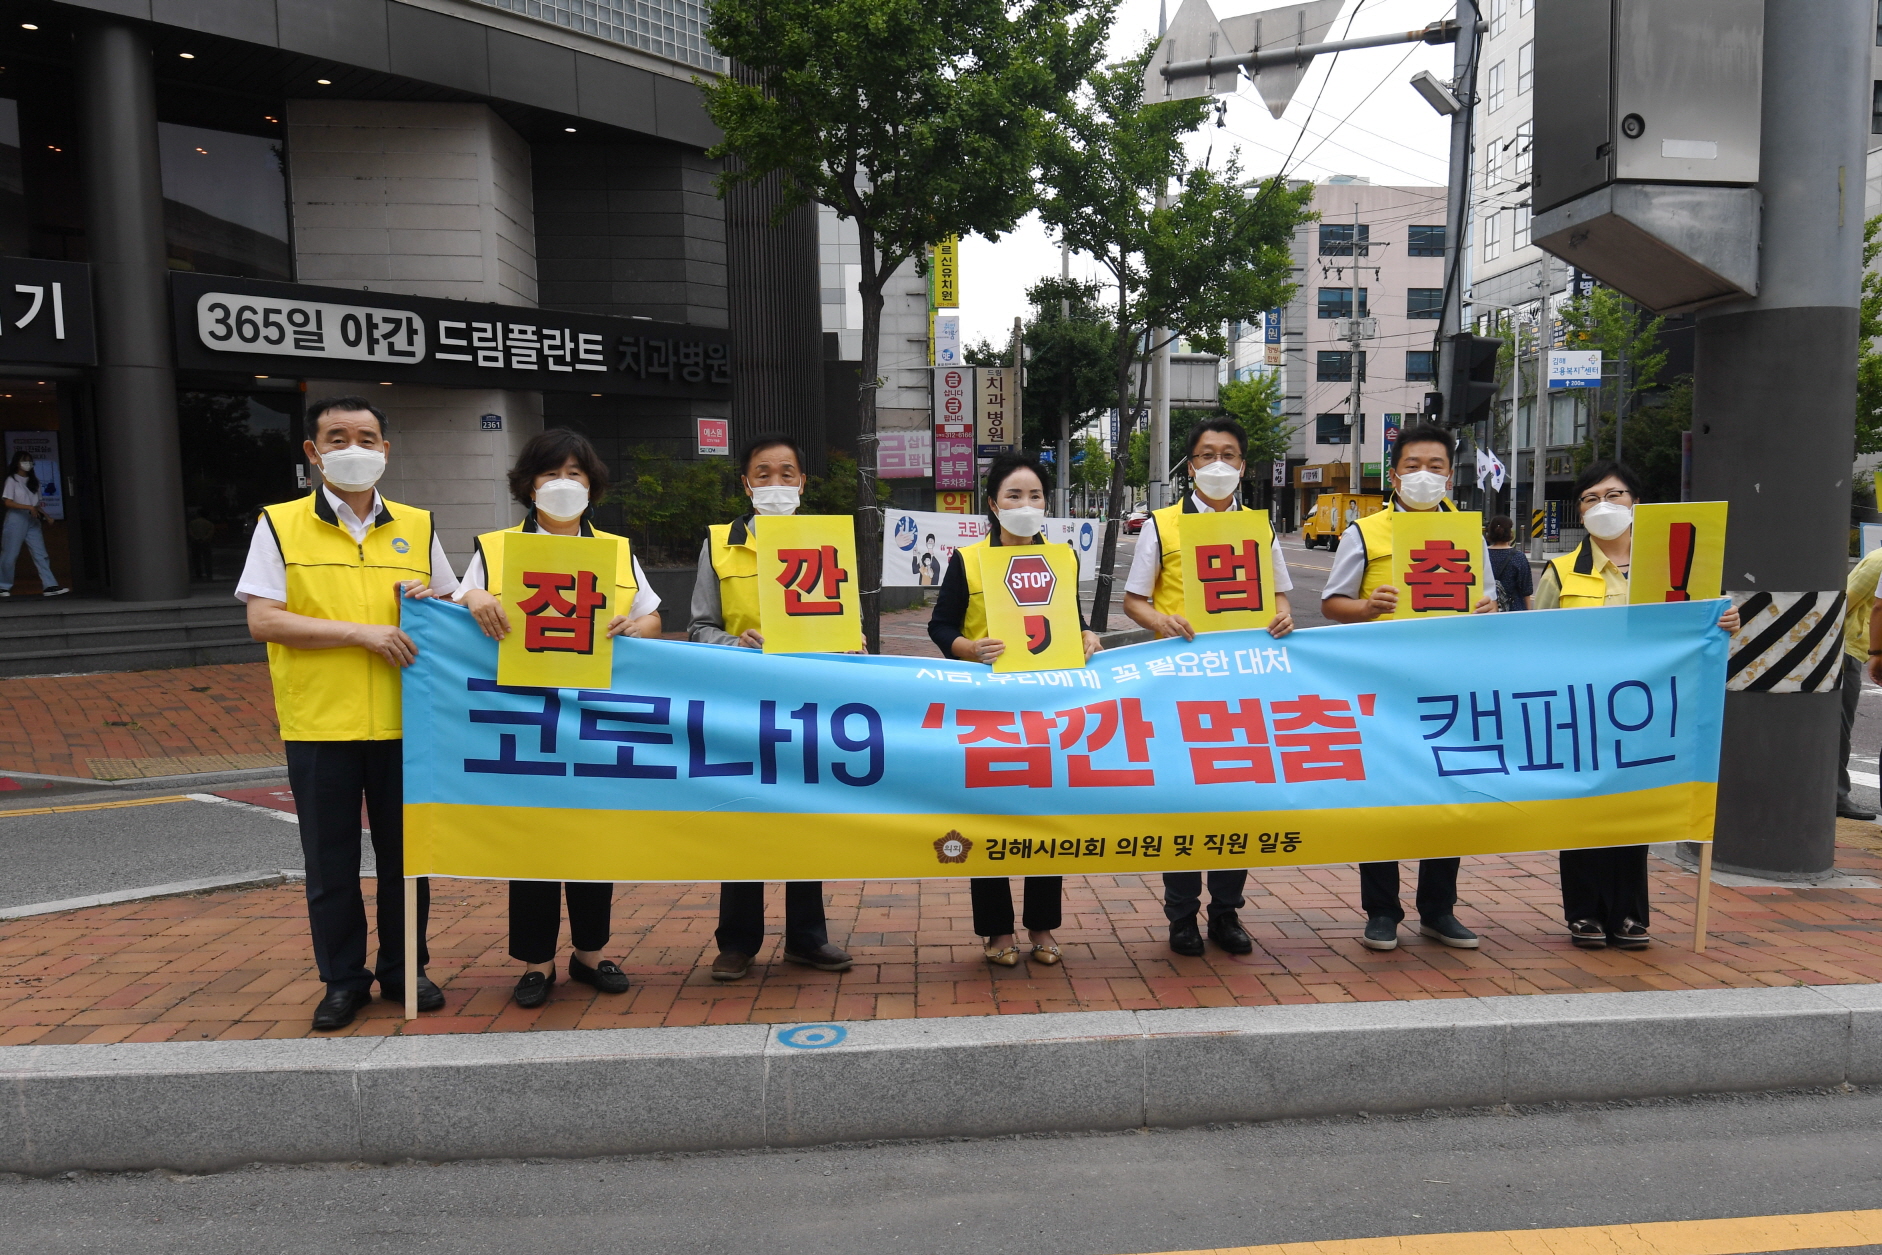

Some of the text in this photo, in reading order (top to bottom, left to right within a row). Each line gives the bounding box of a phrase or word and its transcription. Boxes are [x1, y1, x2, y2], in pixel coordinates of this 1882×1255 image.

[0, 282, 65, 339] 기
[1268, 306, 1278, 340] 병원
[207, 303, 732, 384] 365일 야간 드림플란트 치과병원
[1552, 357, 1566, 365] 김해
[944, 389, 963, 397] 삽니다
[947, 373, 960, 386] 금
[947, 399, 960, 412] 금
[986, 377, 1006, 443] 치과병원
[1385, 415, 1400, 423] VIP
[482, 421, 500, 429] 2361
[879, 434, 906, 468] 금
[908, 435, 932, 449] 삽니
[908, 453, 932, 467] 팝니
[940, 461, 968, 476] 블루
[776, 545, 848, 616] 깐
[1011, 572, 1050, 589] STOP
[1195, 539, 1264, 614] 멈
[1404, 540, 1476, 613] 춤
[516, 570, 606, 655] 잠
[986, 669, 1101, 689] 우리에게
[1111, 664, 1141, 683] 꼭
[1145, 650, 1230, 677] 필요한
[1234, 647, 1292, 675] 대처
[464, 677, 885, 787] 코로나19
[1417, 676, 1678, 777] 캠페인
[944, 844, 961, 853] 의회
[985, 831, 1303, 861] 김해시의회 의원 및 직원 일동
